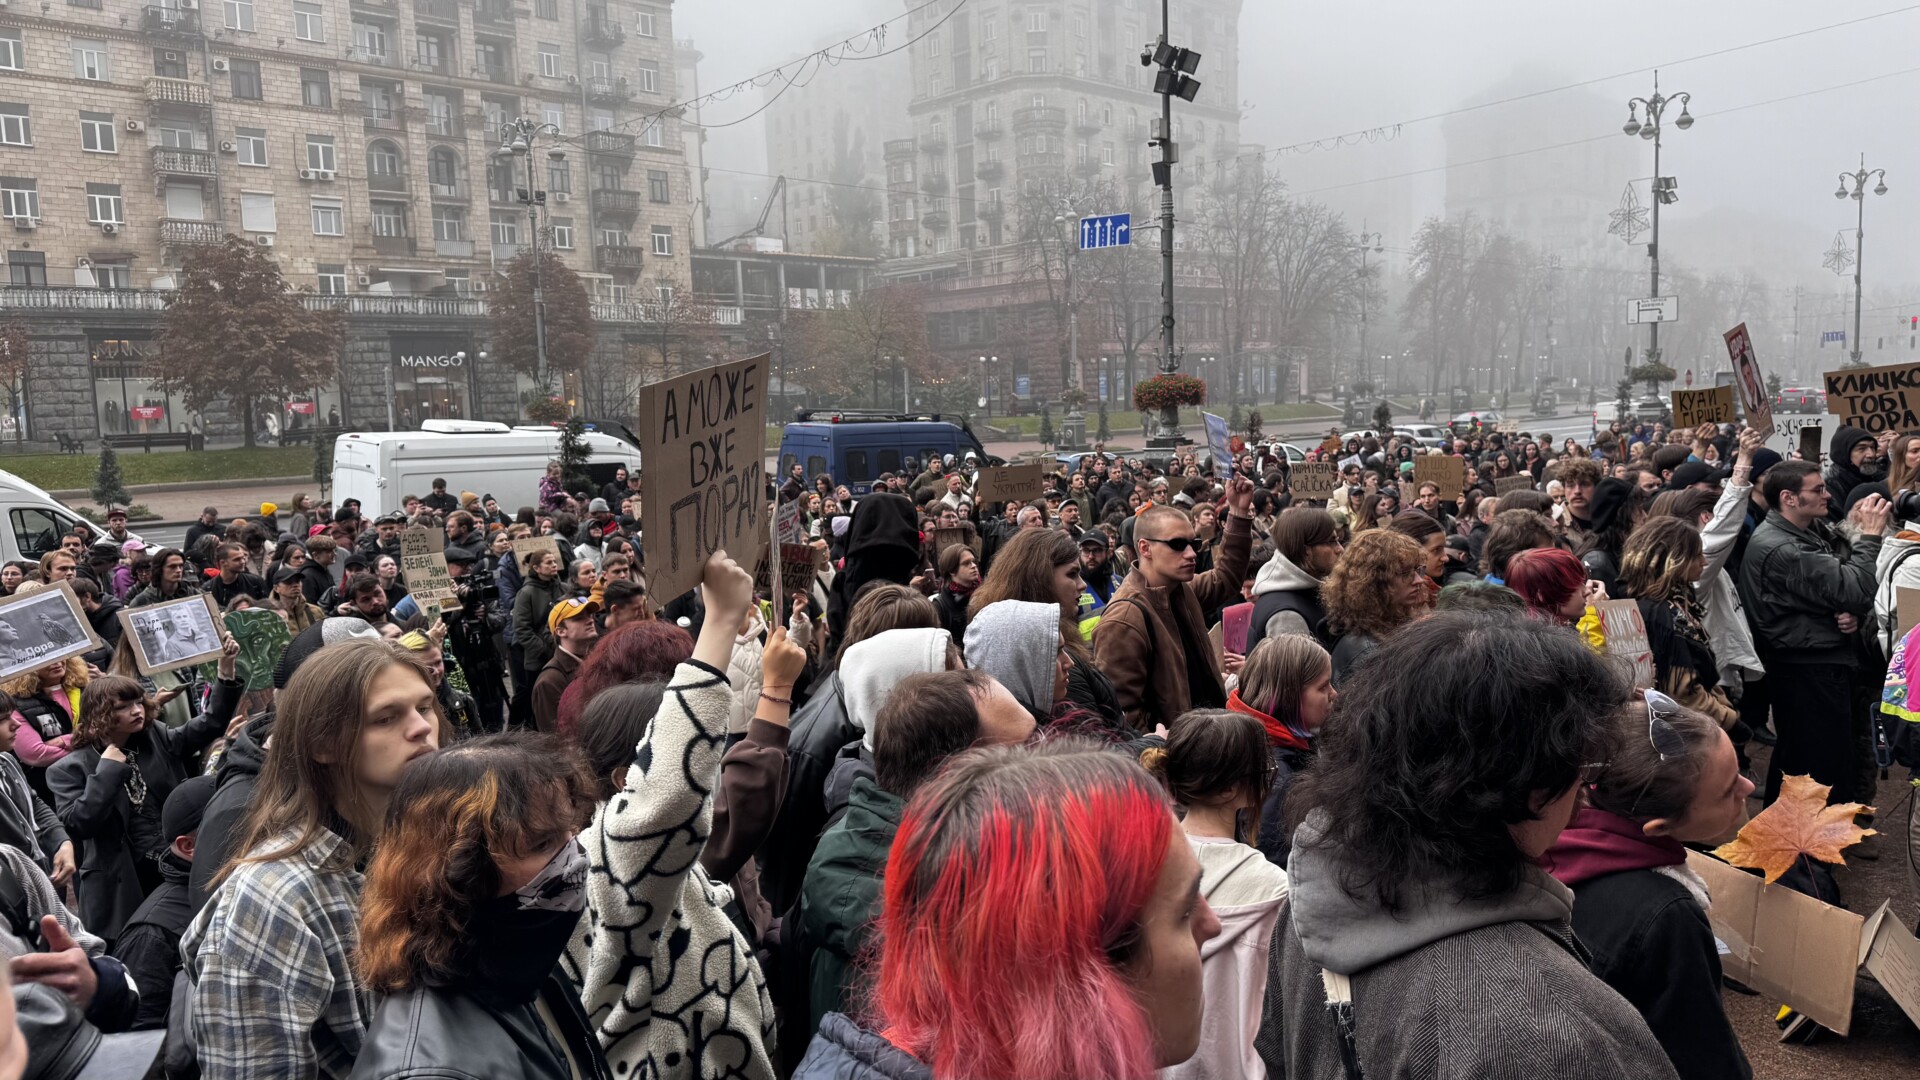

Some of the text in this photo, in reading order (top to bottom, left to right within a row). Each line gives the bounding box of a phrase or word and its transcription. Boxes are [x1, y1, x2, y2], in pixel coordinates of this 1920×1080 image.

[400, 355, 463, 367] MANGO
[1826, 366, 1920, 397] КЛИЧКО
[661, 364, 757, 444] А МОЖЕ
[1678, 389, 1718, 412] КУДИ
[1843, 391, 1908, 415] ТОБІ
[1846, 410, 1919, 433] ПОРА
[690, 427, 736, 489] ВЖЕ
[994, 471, 1009, 483] ДЕ
[992, 479, 1036, 495] УКРИТТЯ?
[670, 460, 759, 574] ПОРА?
[404, 554, 434, 571] ЗЕЛЕНІ
[753, 559, 815, 575] INSTIGATE
[427, 565, 448, 578] ЗОНИ
[754, 573, 811, 590] KLSCHKO
[24, 641, 56, 657] Пора
